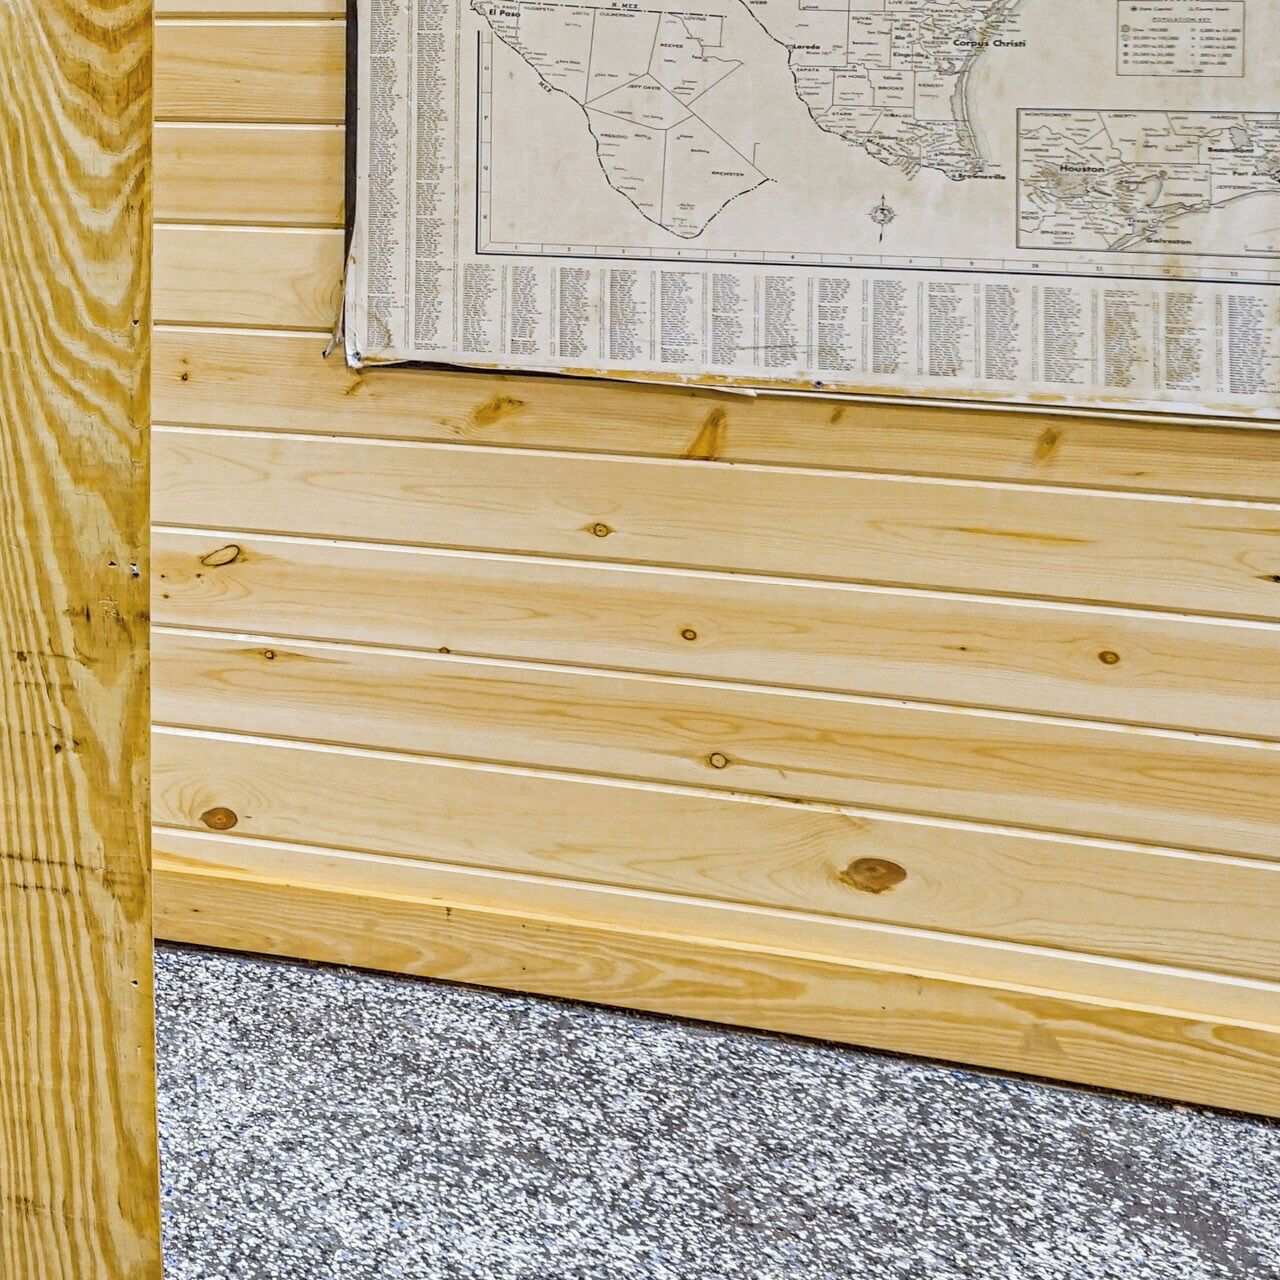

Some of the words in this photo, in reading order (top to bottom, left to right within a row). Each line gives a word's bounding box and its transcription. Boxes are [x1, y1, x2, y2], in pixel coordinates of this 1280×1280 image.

[489, 9, 501, 18] El
[503, 9, 521, 18] Paso
[953, 39, 989, 48] Corpus
[992, 39, 1026, 48] Christi
[1059, 165, 1105, 174] Houston
